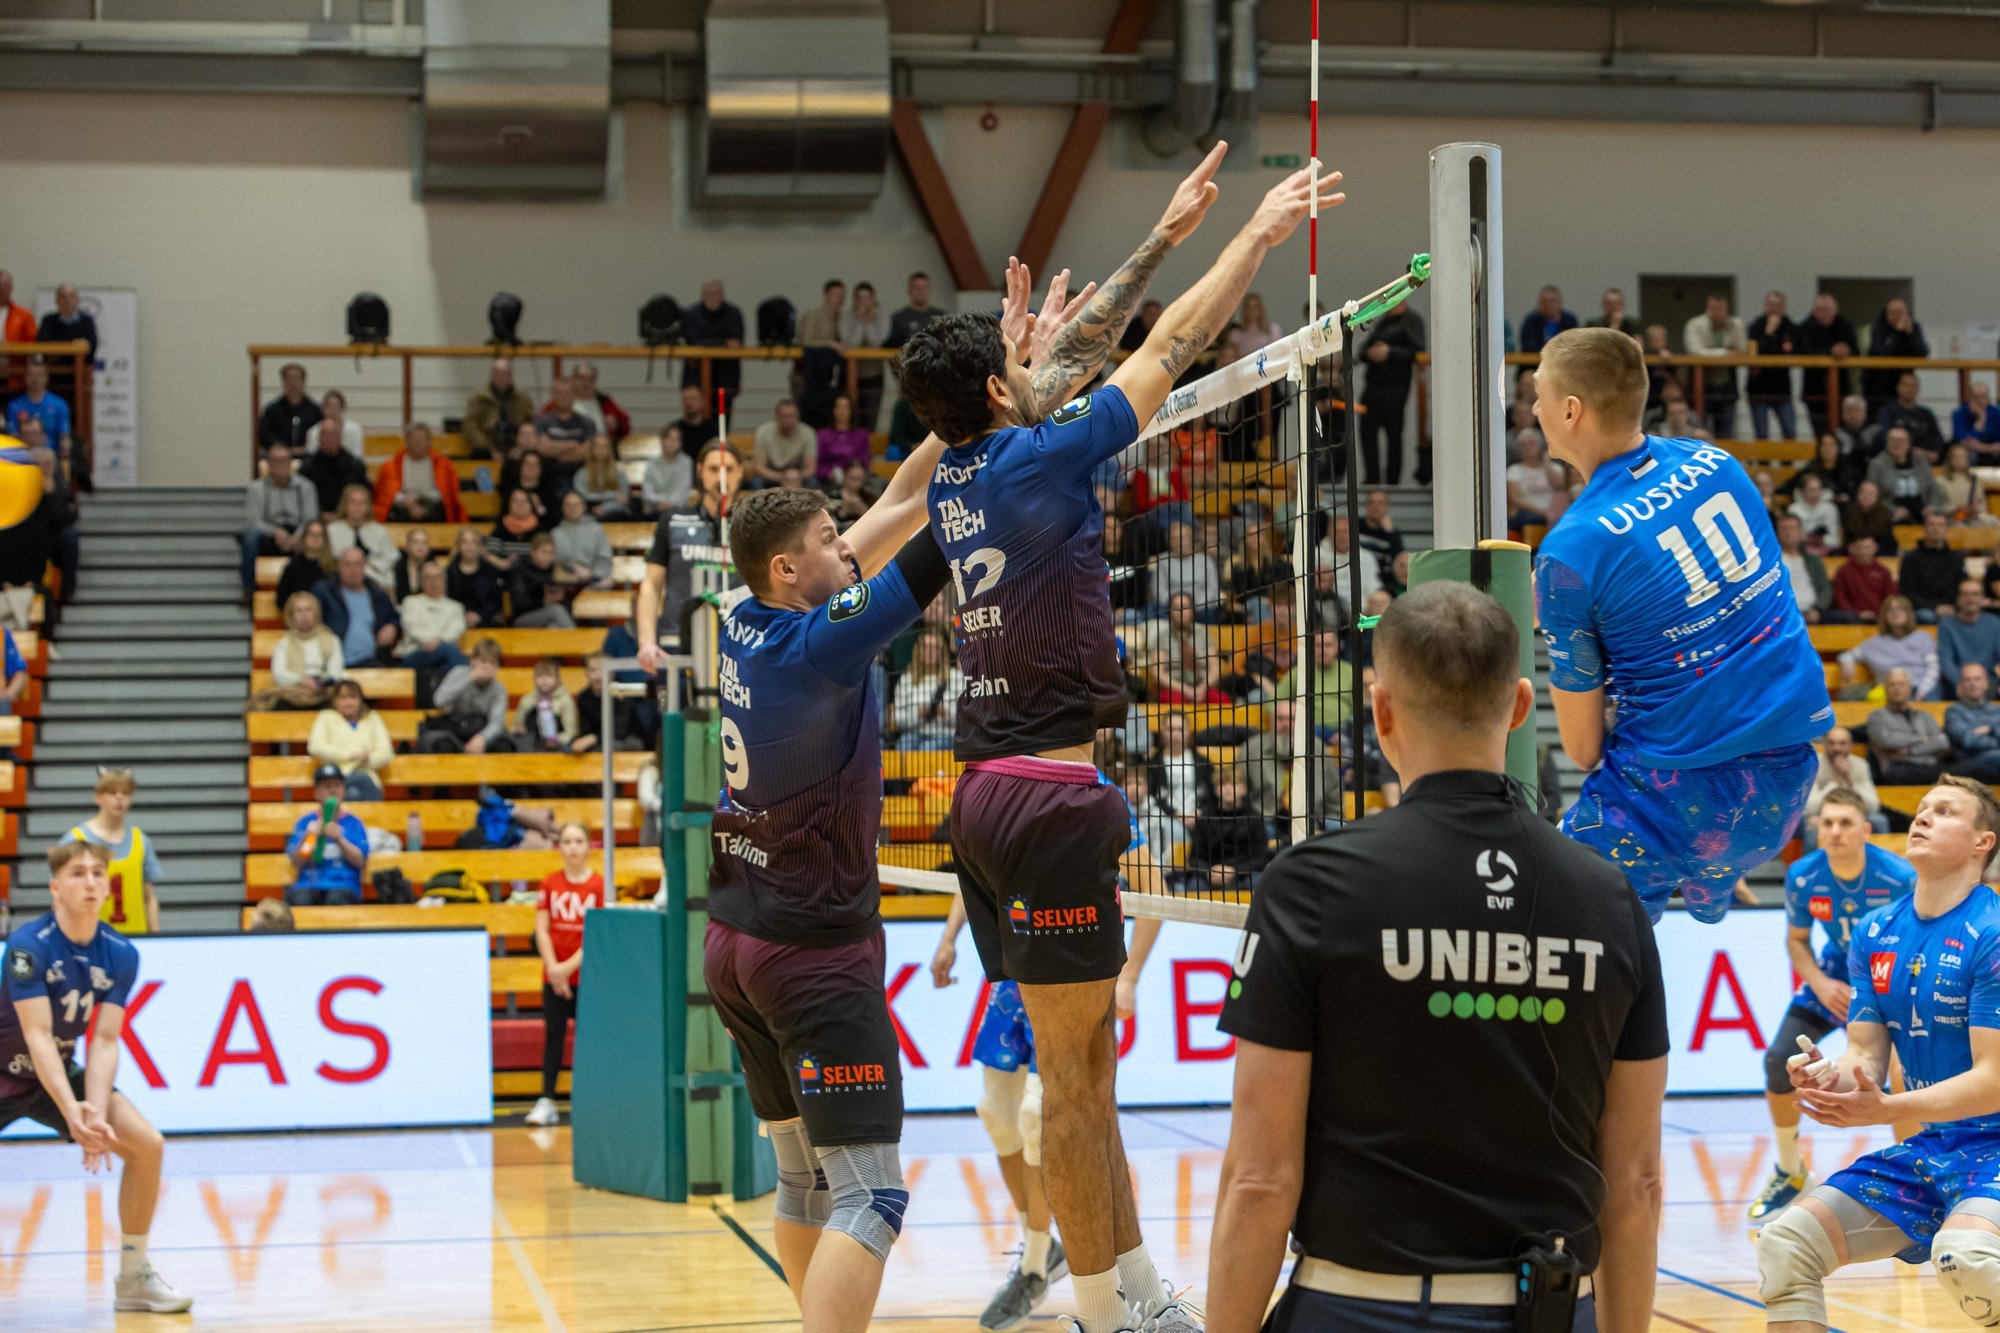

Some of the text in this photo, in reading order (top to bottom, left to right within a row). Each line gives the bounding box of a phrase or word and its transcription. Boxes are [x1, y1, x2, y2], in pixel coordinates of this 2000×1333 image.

[937, 496, 969, 522] TAL
[941, 509, 986, 543] TECH
[1656, 491, 1761, 608] 10
[721, 652, 740, 684] TAL
[719, 672, 751, 709] TECH
[720, 716, 749, 790] 9
[109, 873, 127, 923] 1
[550, 890, 596, 921] KM
[1486, 895, 1514, 910] EVF
[1033, 906, 1098, 928] SELVER
[1381, 928, 1604, 992] UNIBET
[60, 988, 95, 1024] 11
[822, 1064, 886, 1085] SELVER
